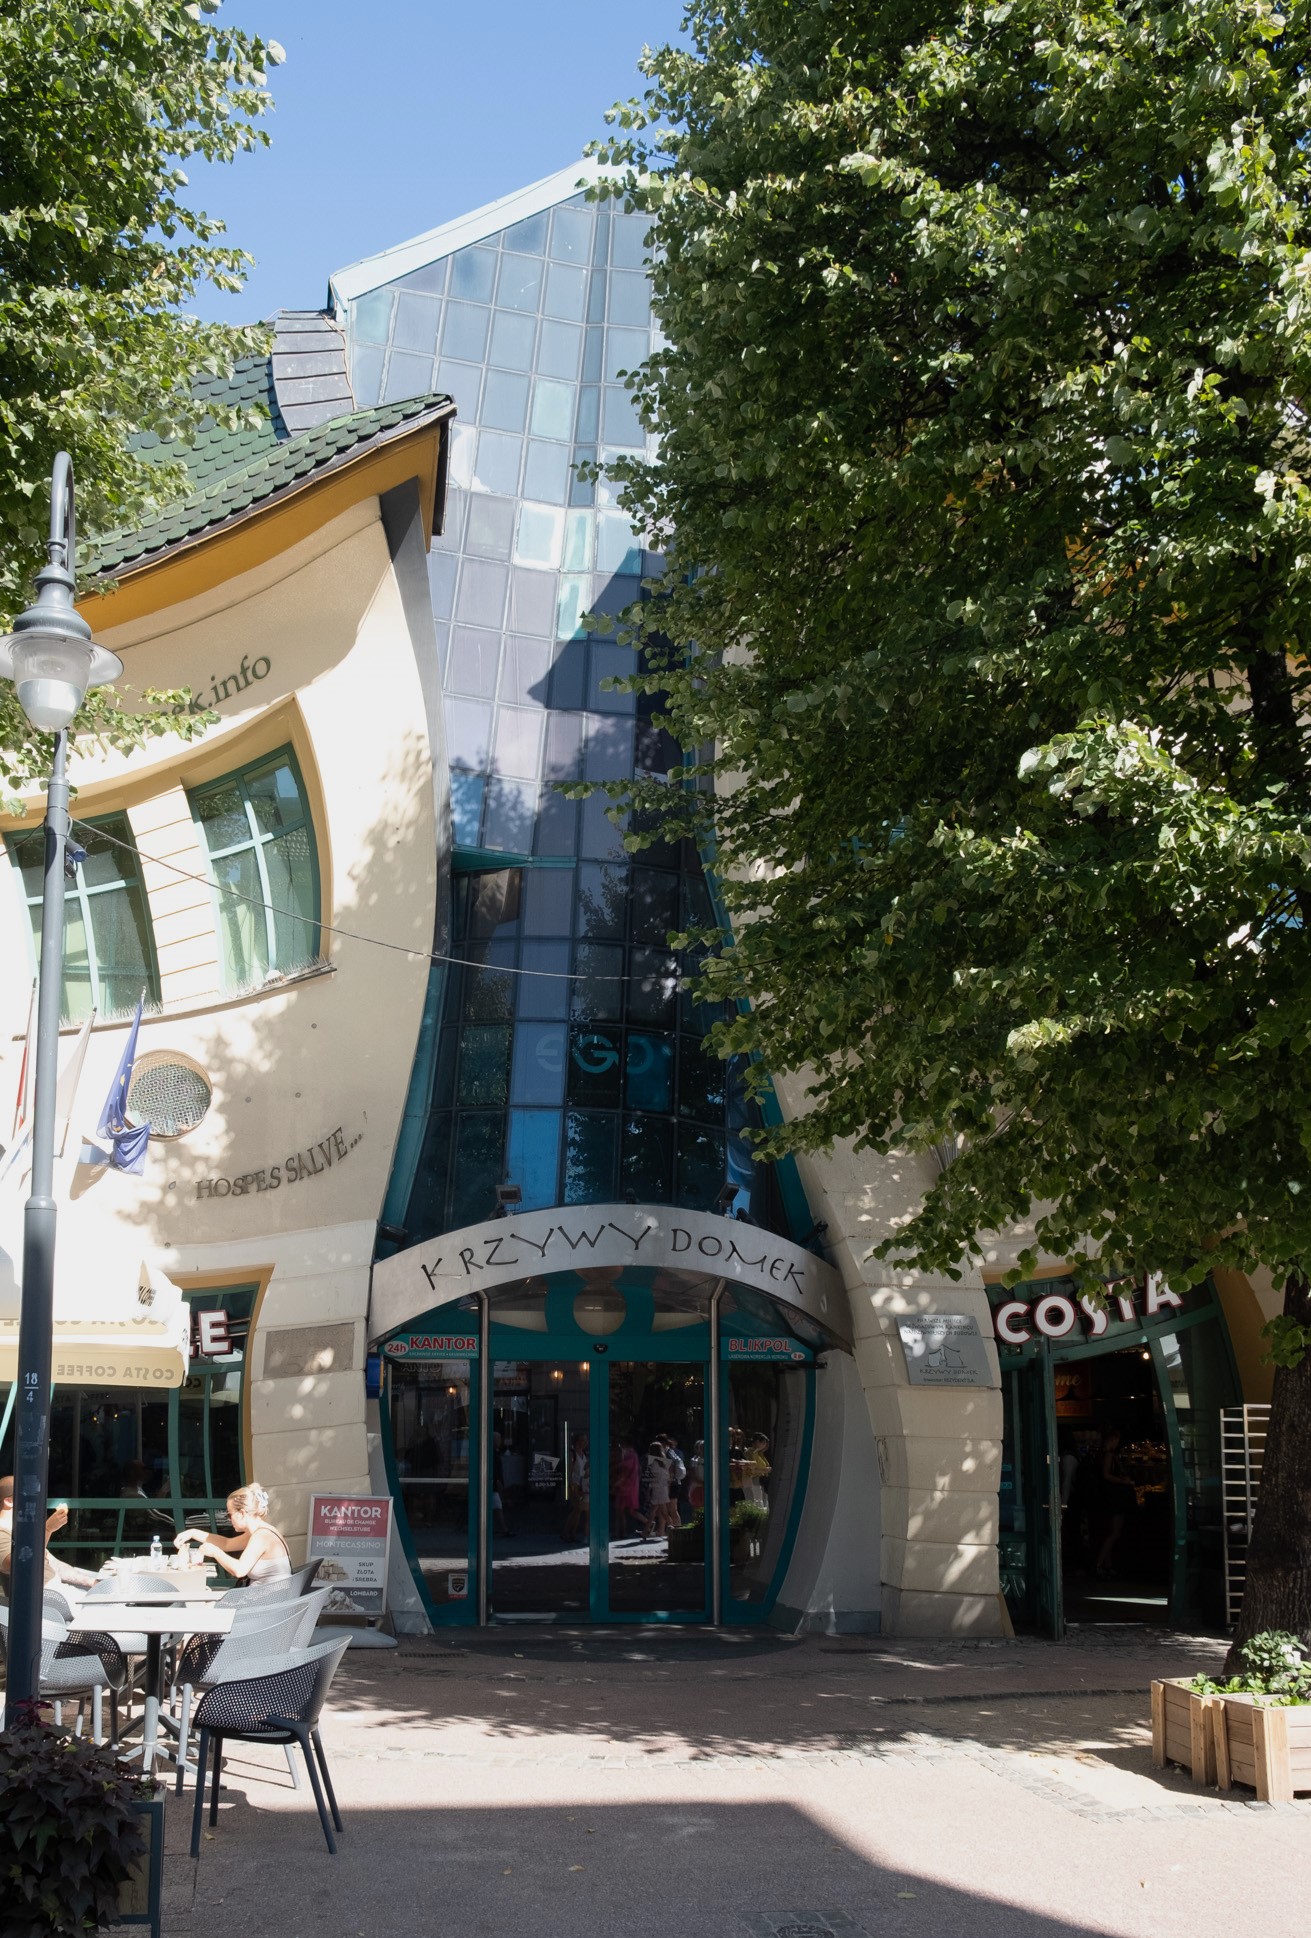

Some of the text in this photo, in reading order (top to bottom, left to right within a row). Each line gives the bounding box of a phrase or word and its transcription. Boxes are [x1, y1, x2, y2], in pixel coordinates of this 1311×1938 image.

[195, 1166, 281, 1199] HOSPES
[421, 1222, 805, 1294] KRZYWY DOMEK
[995, 1270, 1184, 1345] COSTA
[388, 1336, 477, 1354] 24h KANTOR
[728, 1339, 792, 1352] BLIKPOL
[24, 1372, 38, 1385] 18
[26, 1391, 34, 1403] 4
[320, 1505, 382, 1519] KANTOR
[316, 1541, 381, 1549] MONTECASSINO
